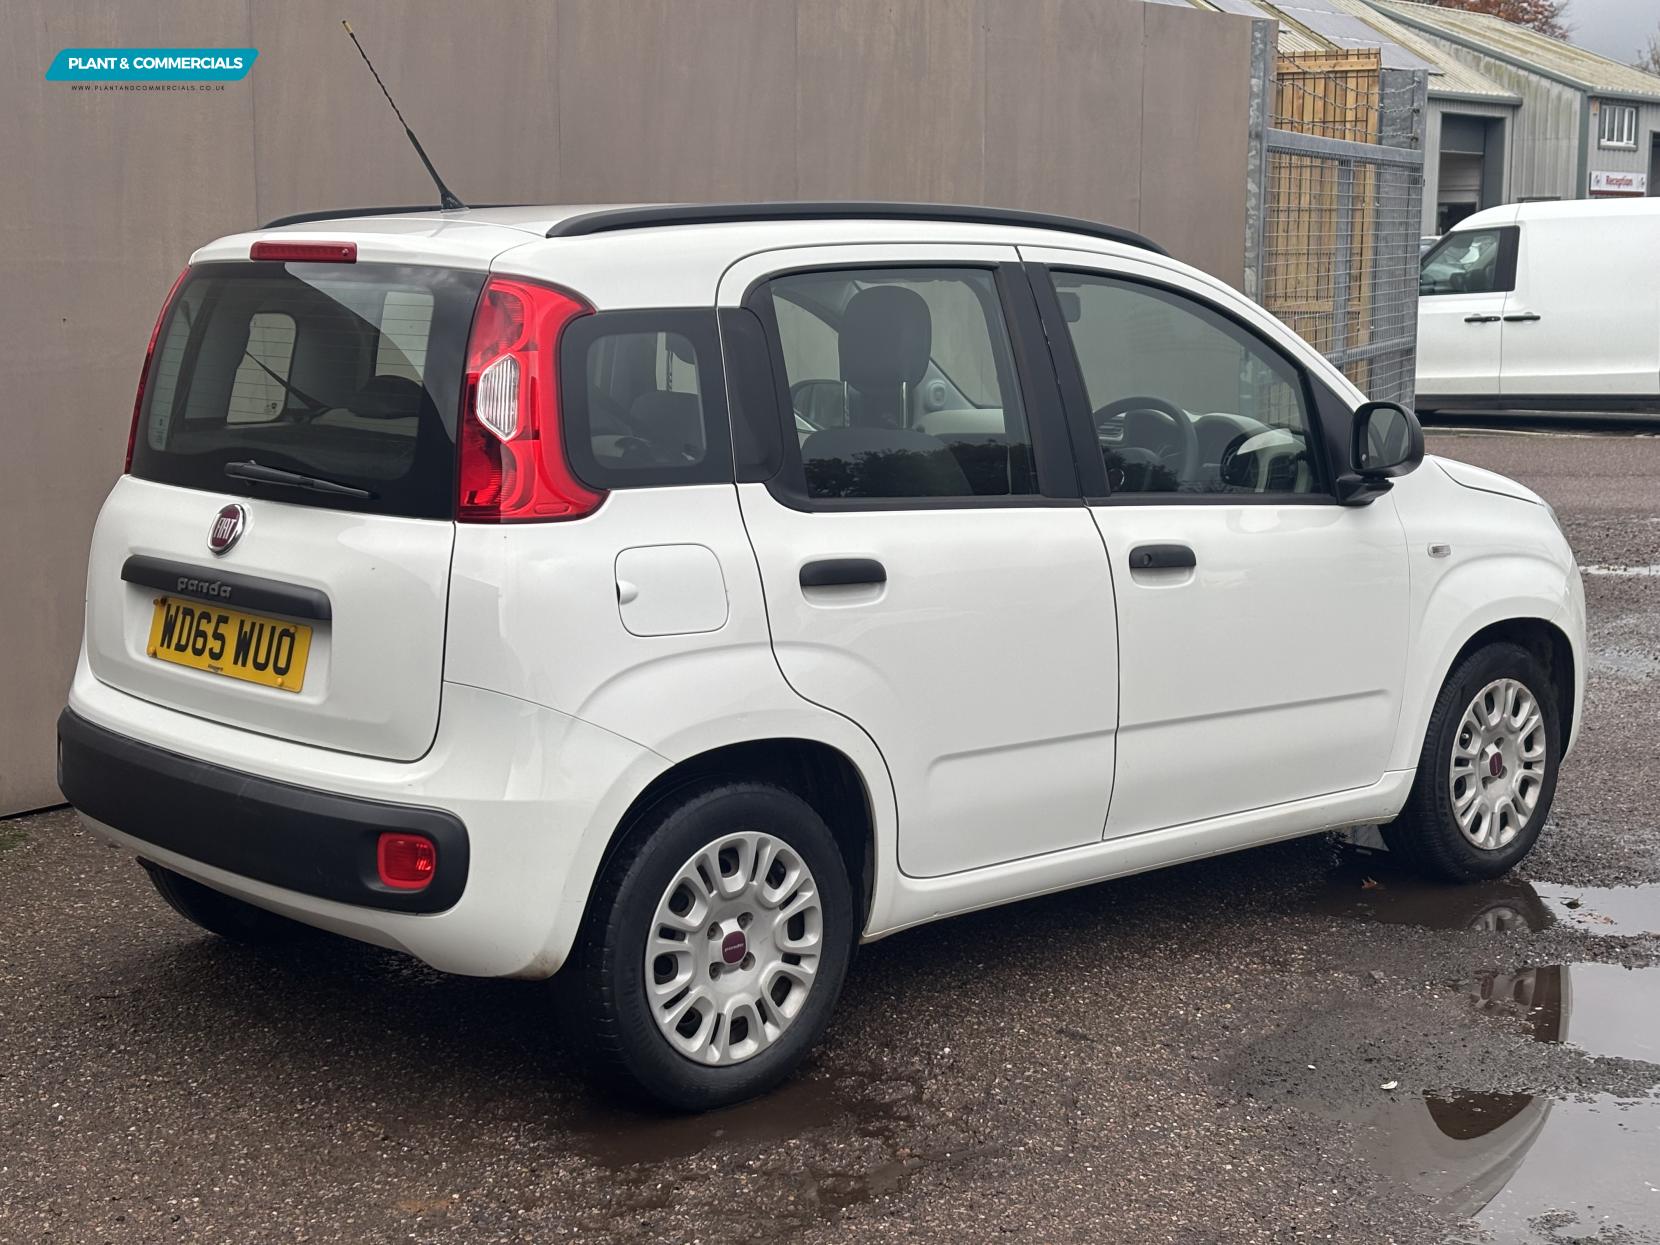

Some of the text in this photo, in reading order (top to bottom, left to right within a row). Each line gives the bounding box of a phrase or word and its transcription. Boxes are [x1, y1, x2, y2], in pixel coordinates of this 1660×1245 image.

[213, 517, 237, 539] FIAT
[177, 577, 232, 598] panda
[160, 603, 296, 676] WD65 WUO
